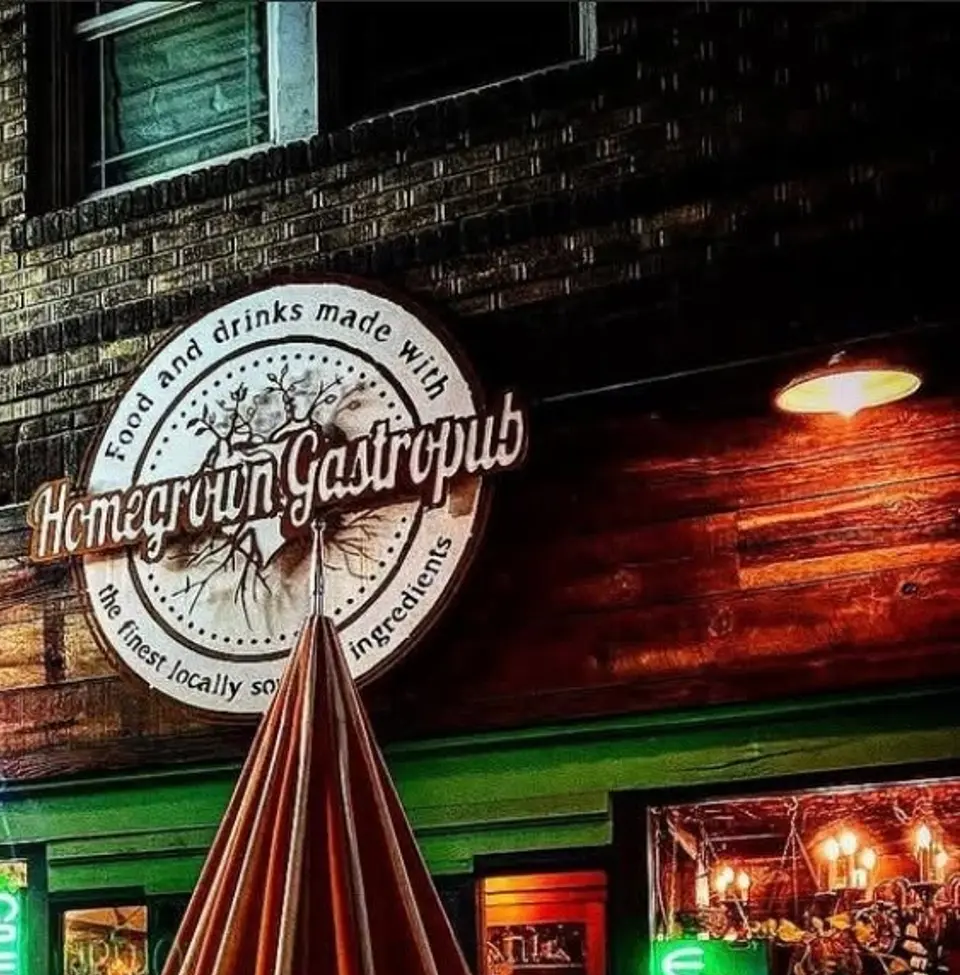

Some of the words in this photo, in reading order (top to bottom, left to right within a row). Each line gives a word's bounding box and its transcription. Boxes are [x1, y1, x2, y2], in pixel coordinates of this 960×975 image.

[105, 392, 154, 461] Food
[157, 338, 203, 389] and
[213, 300, 303, 344] drinks
[315, 303, 391, 342] made
[398, 339, 448, 400] with
[32, 458, 273, 561] Homegrown
[287, 392, 525, 527] Gastropub
[98, 583, 121, 620] the
[117, 619, 167, 672] finest
[167, 660, 242, 702] locally
[348, 535, 452, 660] ingredients
